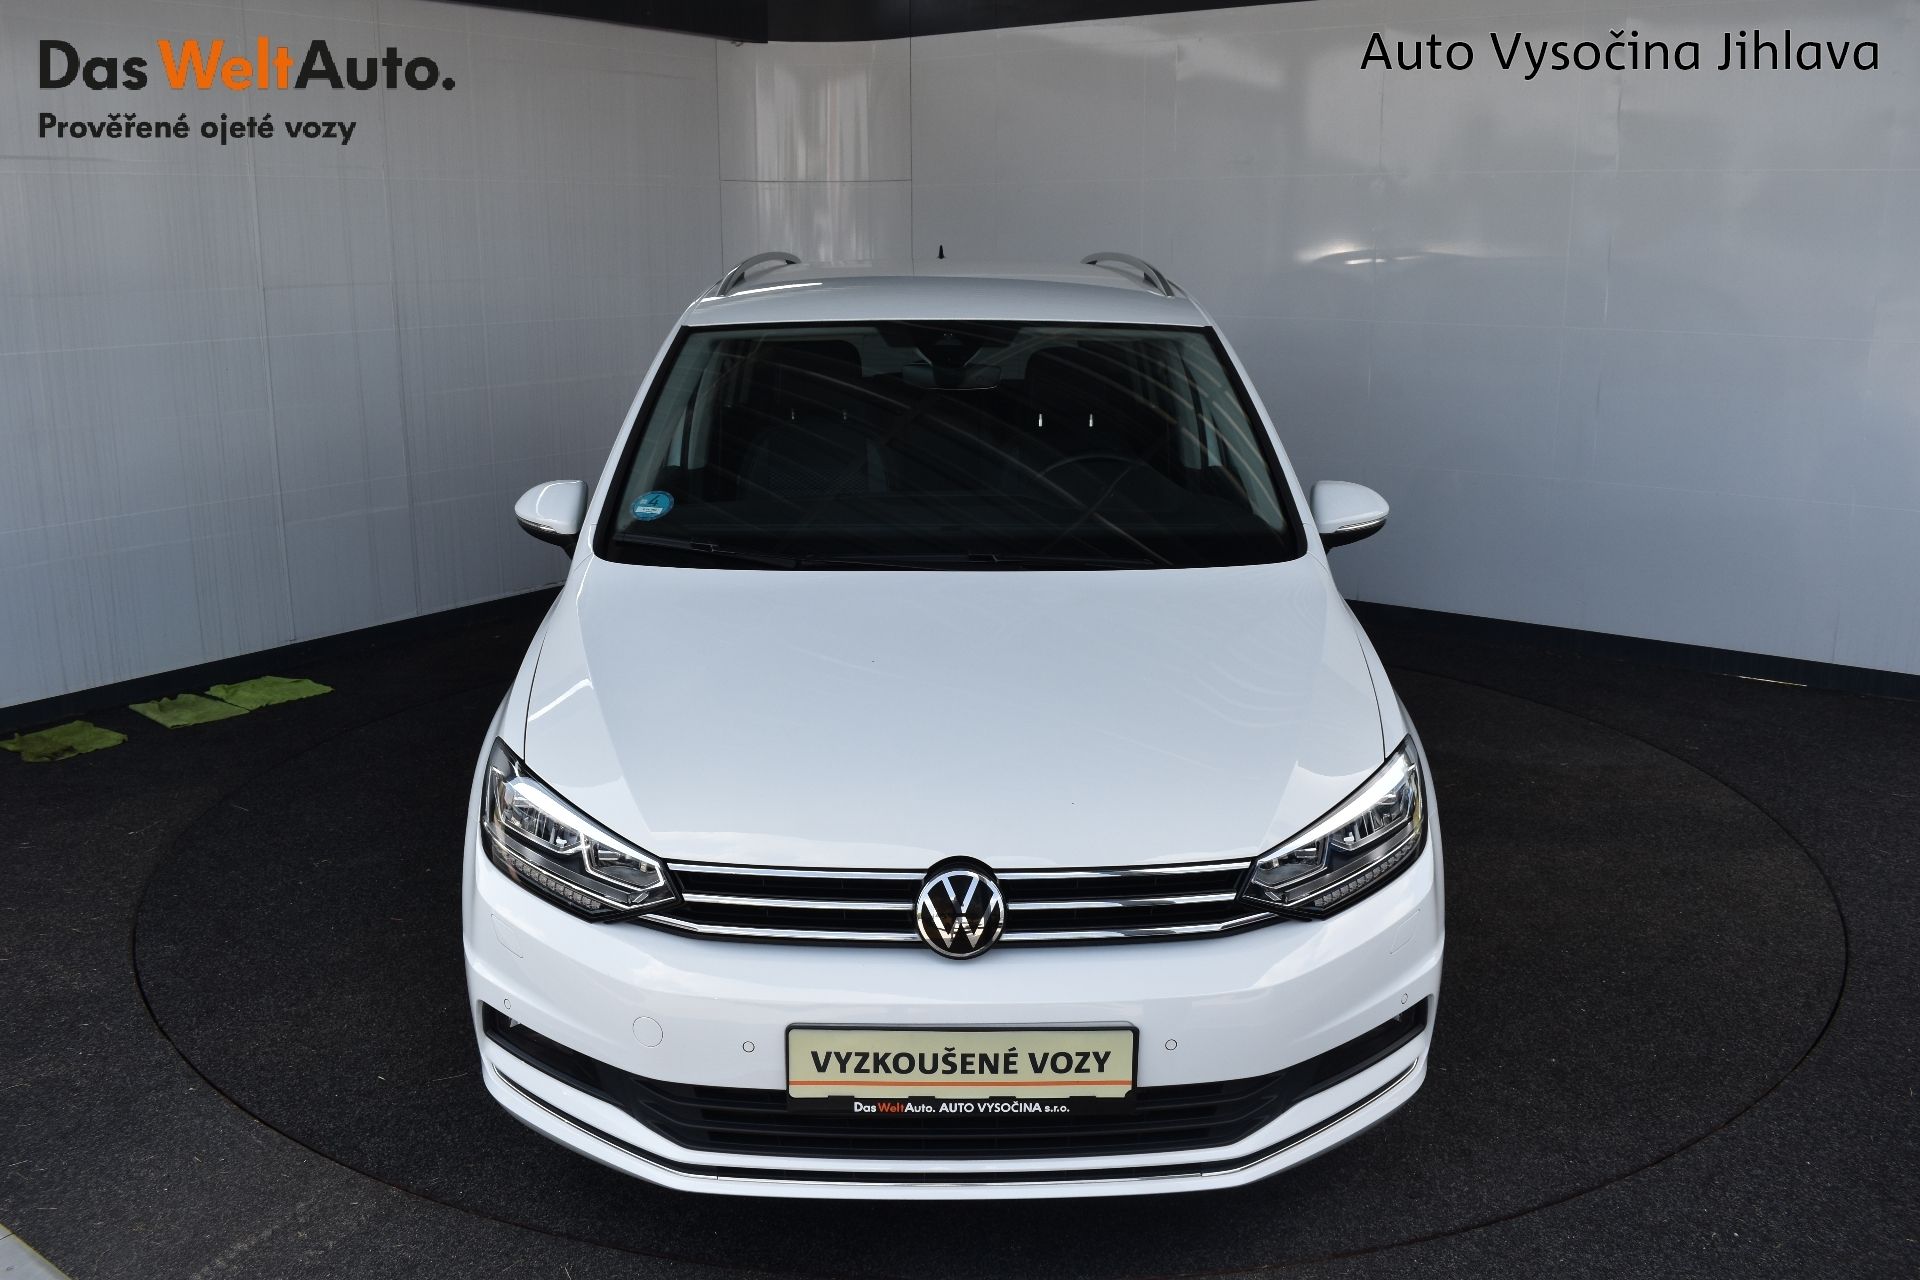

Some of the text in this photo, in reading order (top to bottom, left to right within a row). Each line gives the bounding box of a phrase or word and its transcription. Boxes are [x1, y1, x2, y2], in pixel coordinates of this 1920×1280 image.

[810, 1047, 1112, 1075] VYZKOUŠENÉ VOZY
[939, 1102, 975, 1113] AUTO
[977, 1100, 1042, 1113] VYSOČINA
[1044, 1104, 1070, 1113] s.r.o.
